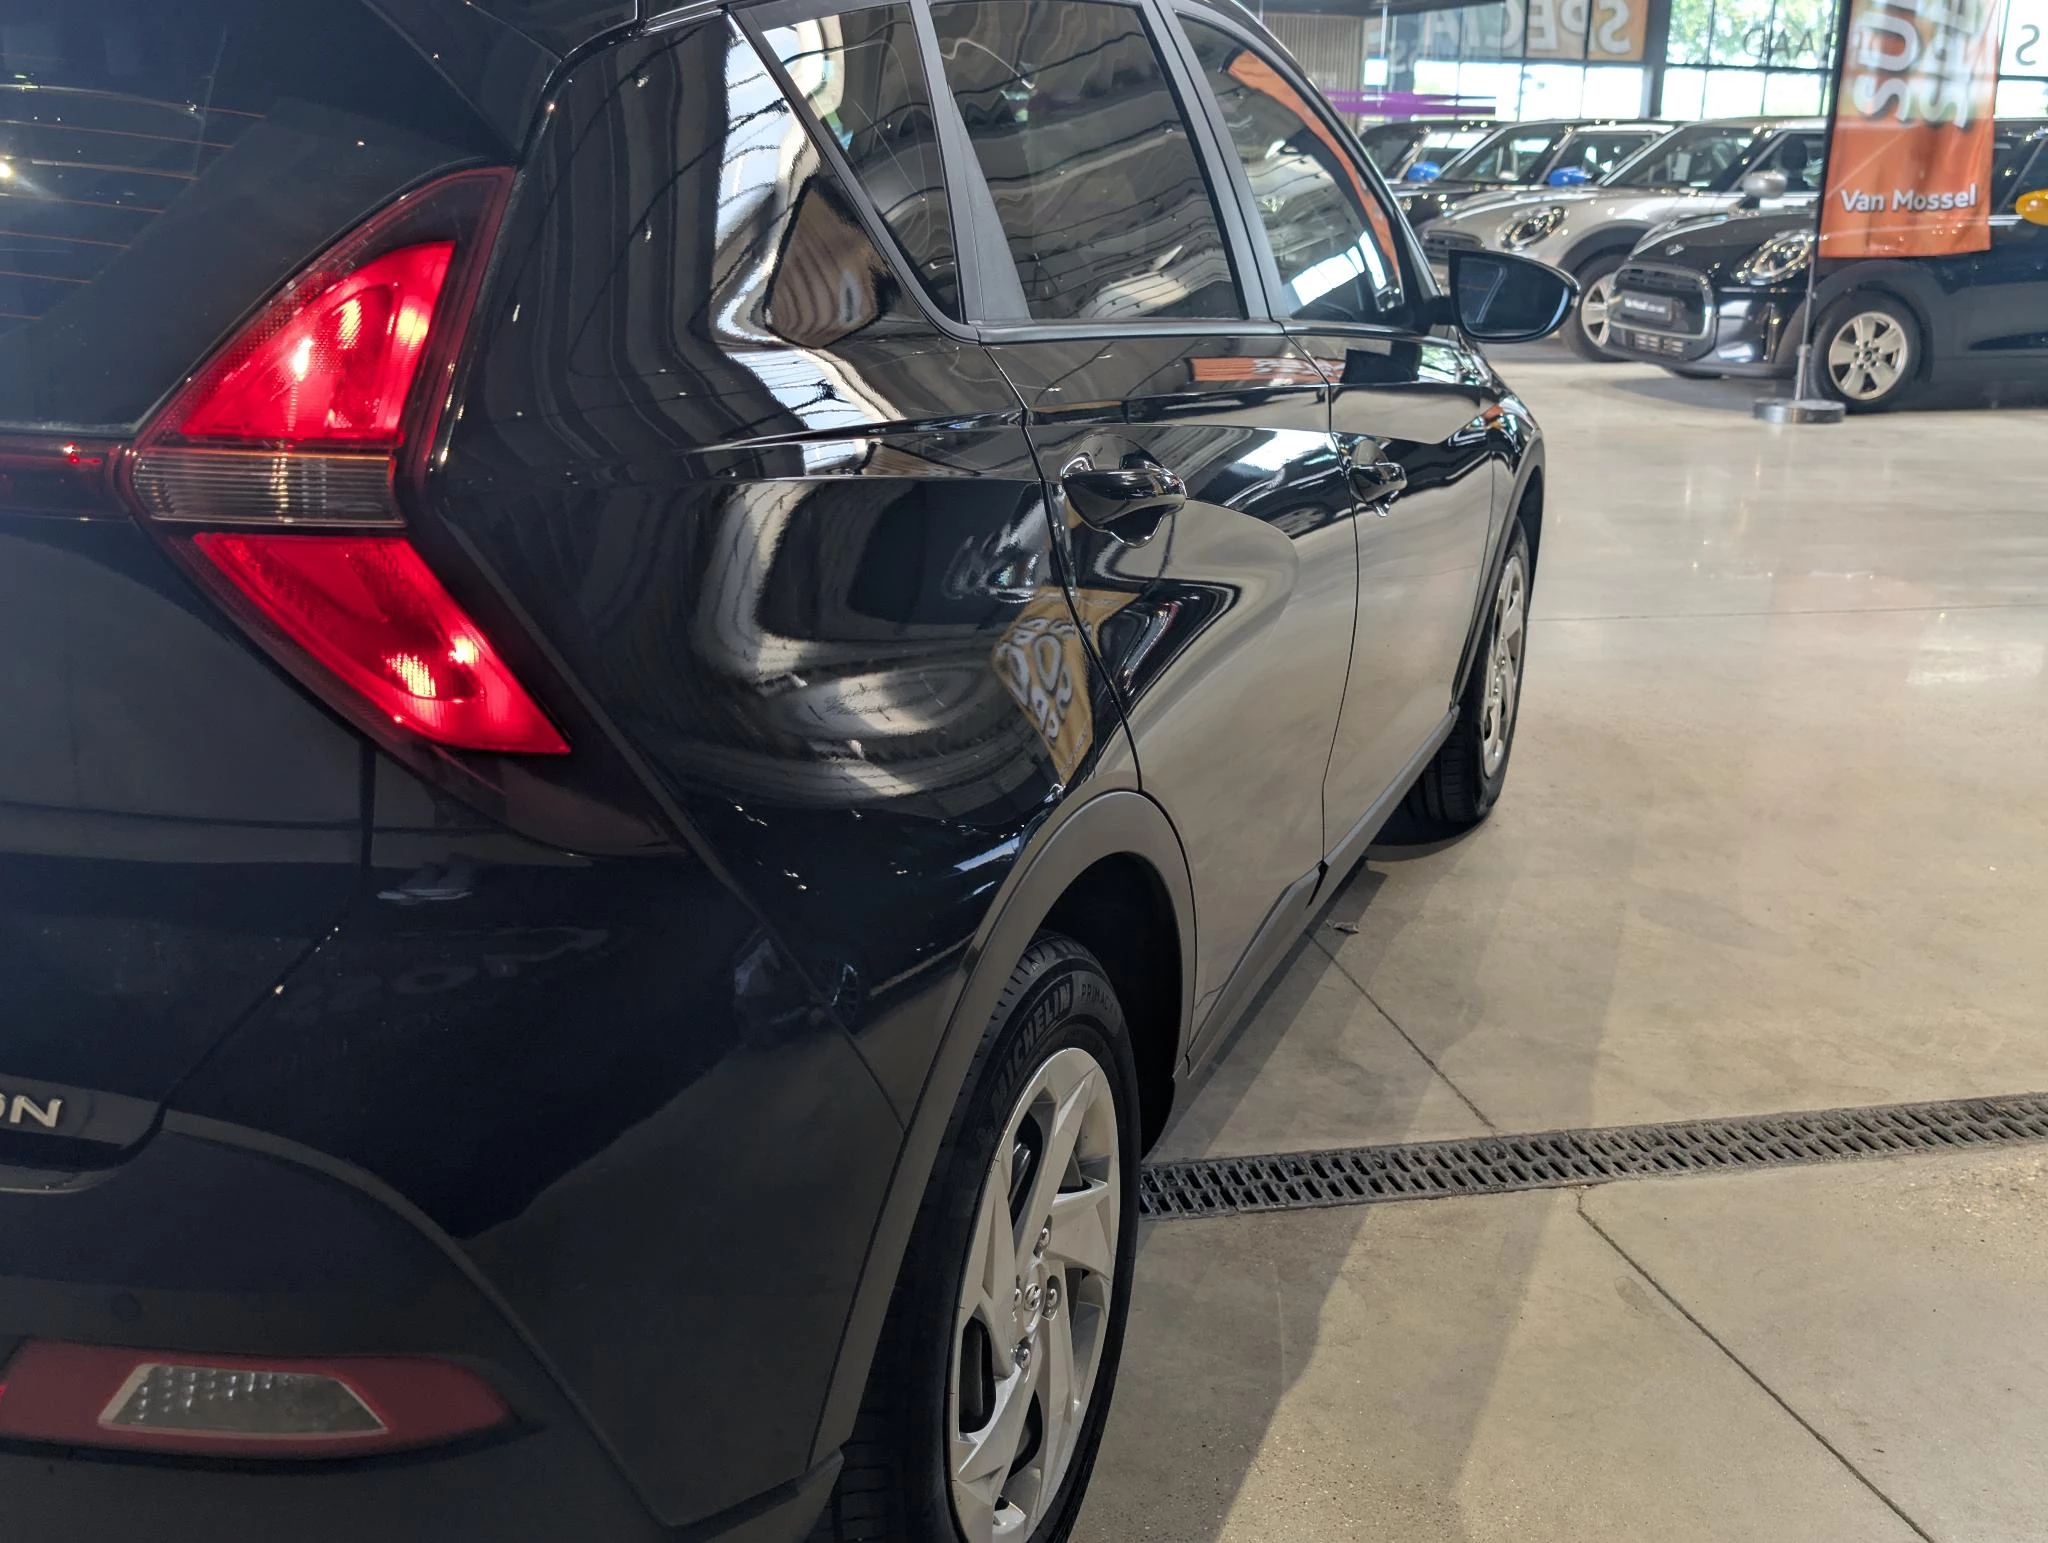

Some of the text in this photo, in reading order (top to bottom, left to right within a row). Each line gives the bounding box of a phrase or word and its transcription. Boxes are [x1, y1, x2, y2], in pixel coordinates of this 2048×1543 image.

[1840, 183, 1978, 212] Van Mossel
[0, 1092, 63, 1128] N
